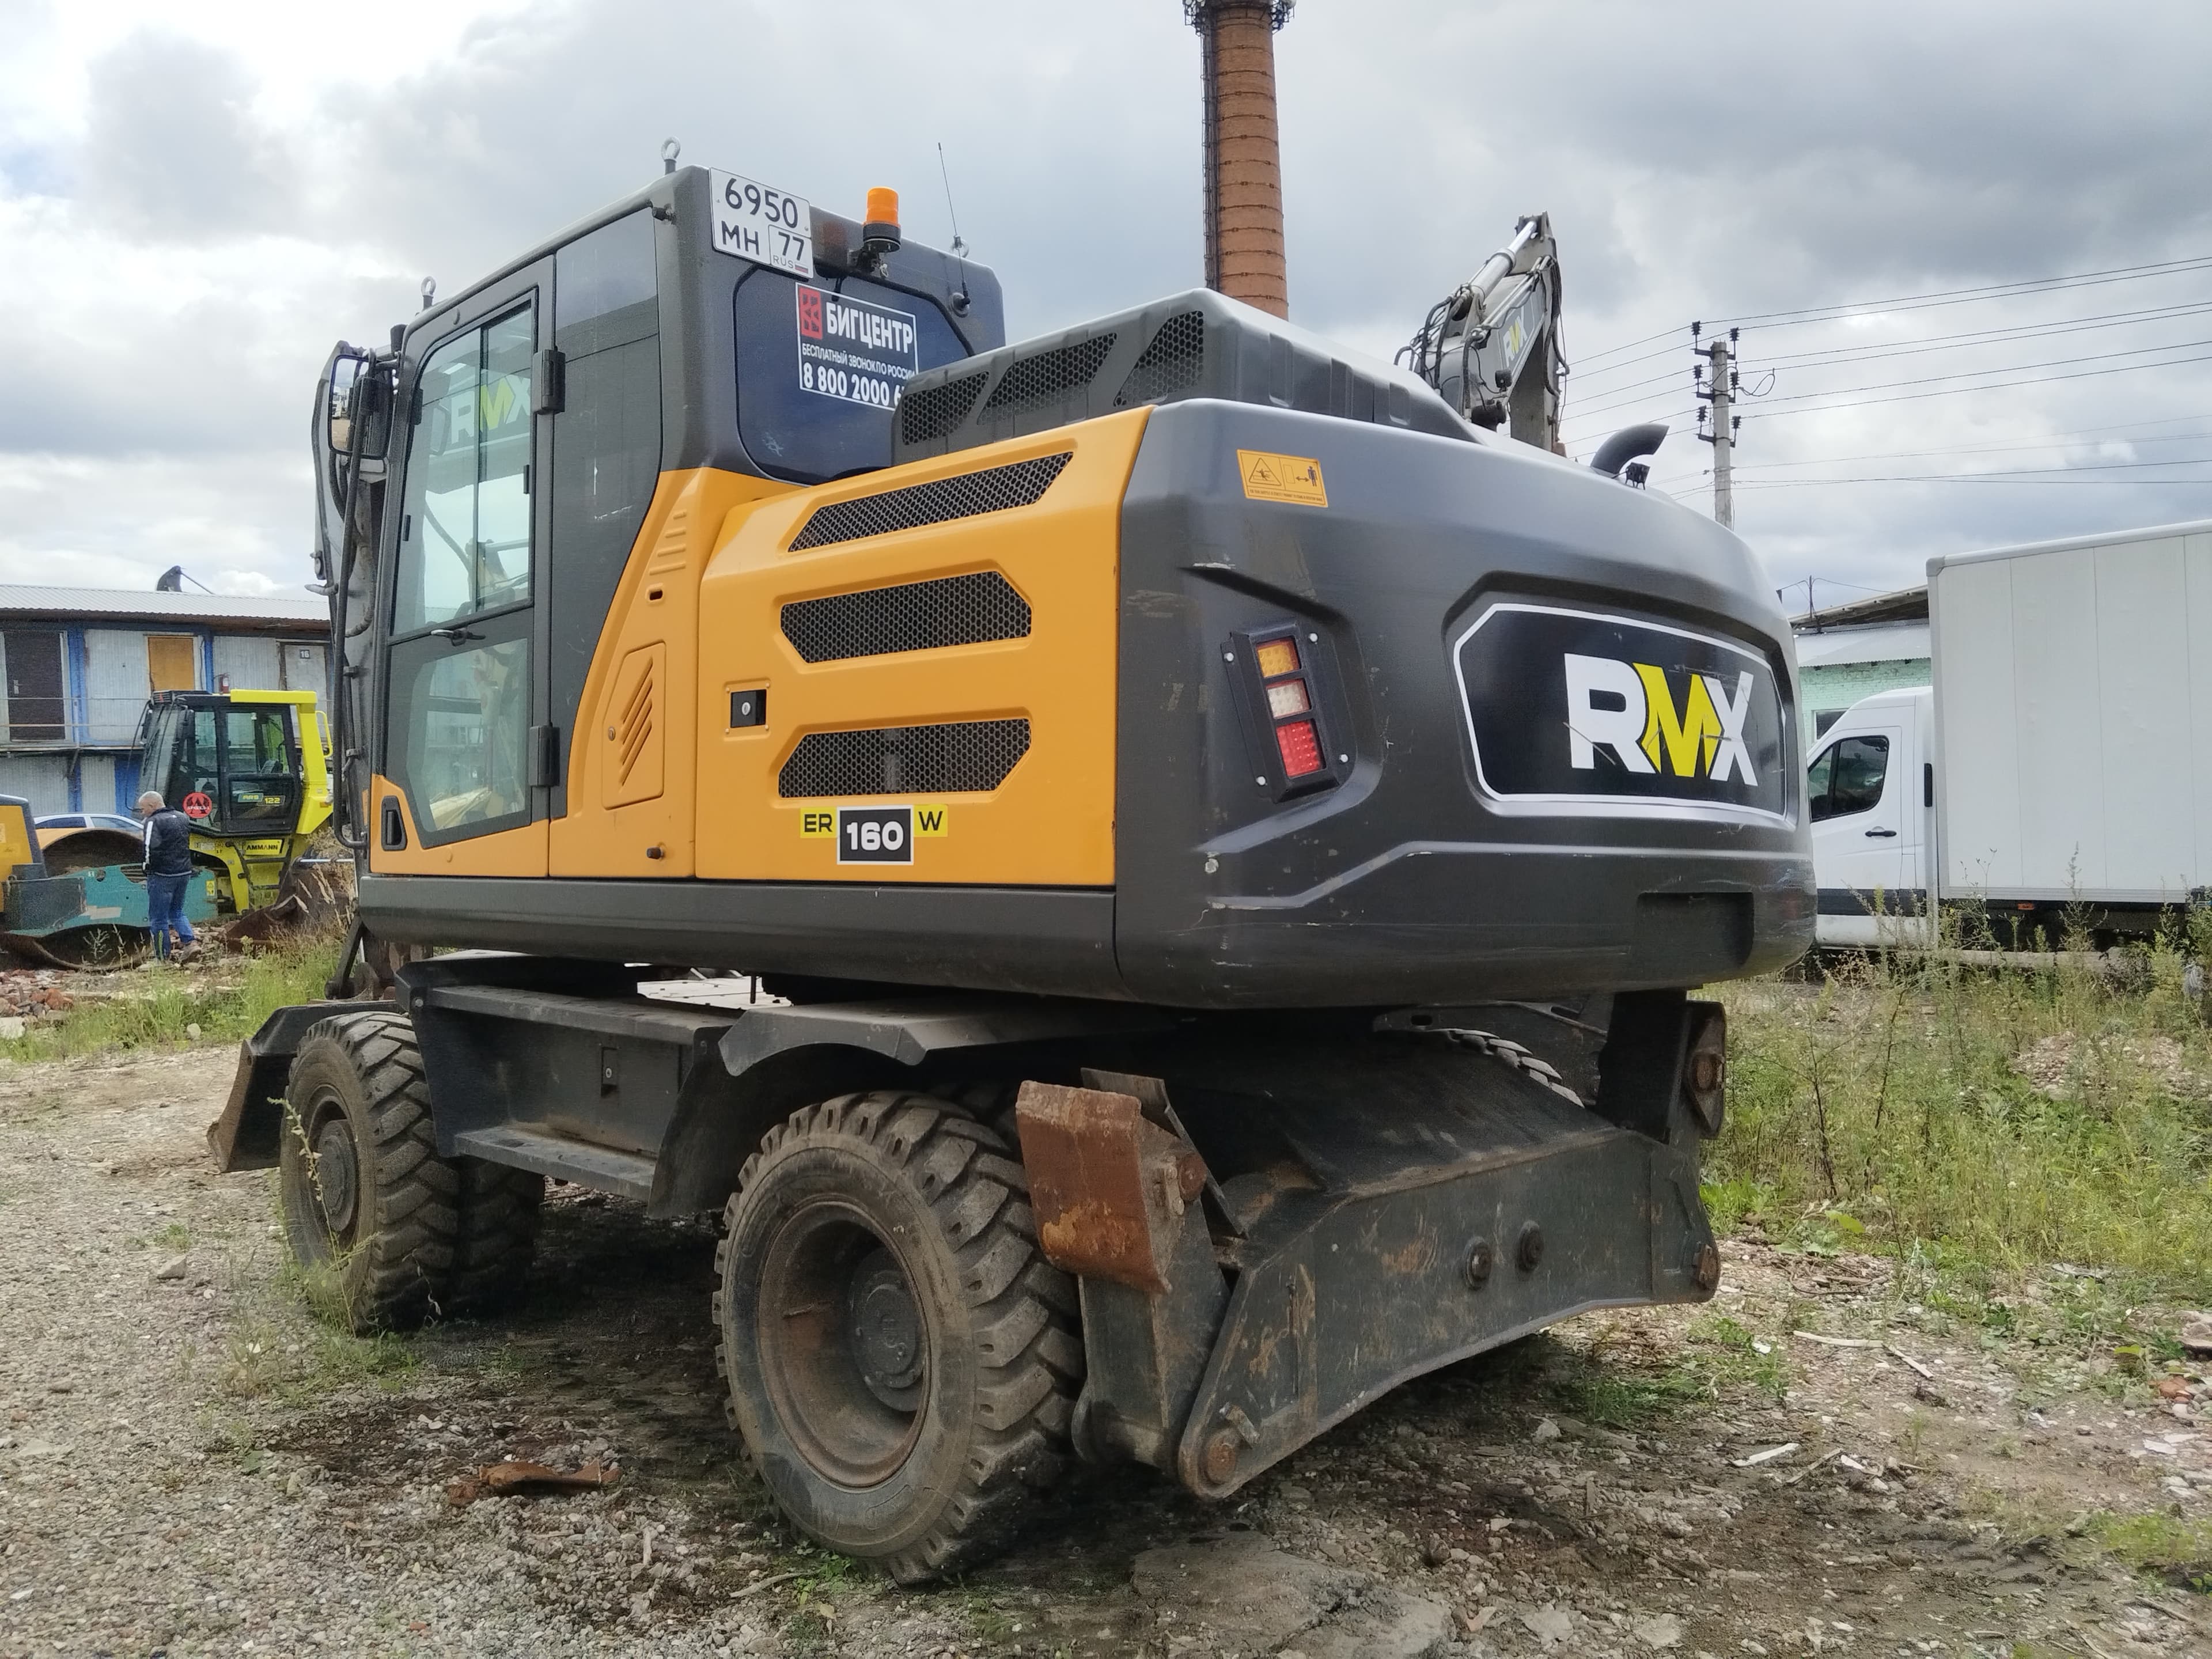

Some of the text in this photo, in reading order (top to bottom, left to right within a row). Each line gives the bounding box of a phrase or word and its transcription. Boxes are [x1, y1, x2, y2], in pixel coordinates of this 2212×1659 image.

[725, 178, 798, 229] 6950
[773, 255, 794, 268] RUS
[778, 231, 804, 261] 77
[826, 301, 914, 354] БИГЦЕНТР
[802, 342, 848, 365] БЕСПЛАТНЫЙ
[849, 354, 877, 372] ЗВОНОК
[877, 361, 887, 375] ПО
[803, 362, 813, 388] 8
[817, 366, 847, 397] 800
[851, 374, 890, 406] 2000
[1563, 653, 1758, 786] RMX
[804, 810, 943, 851] ER 160 W
